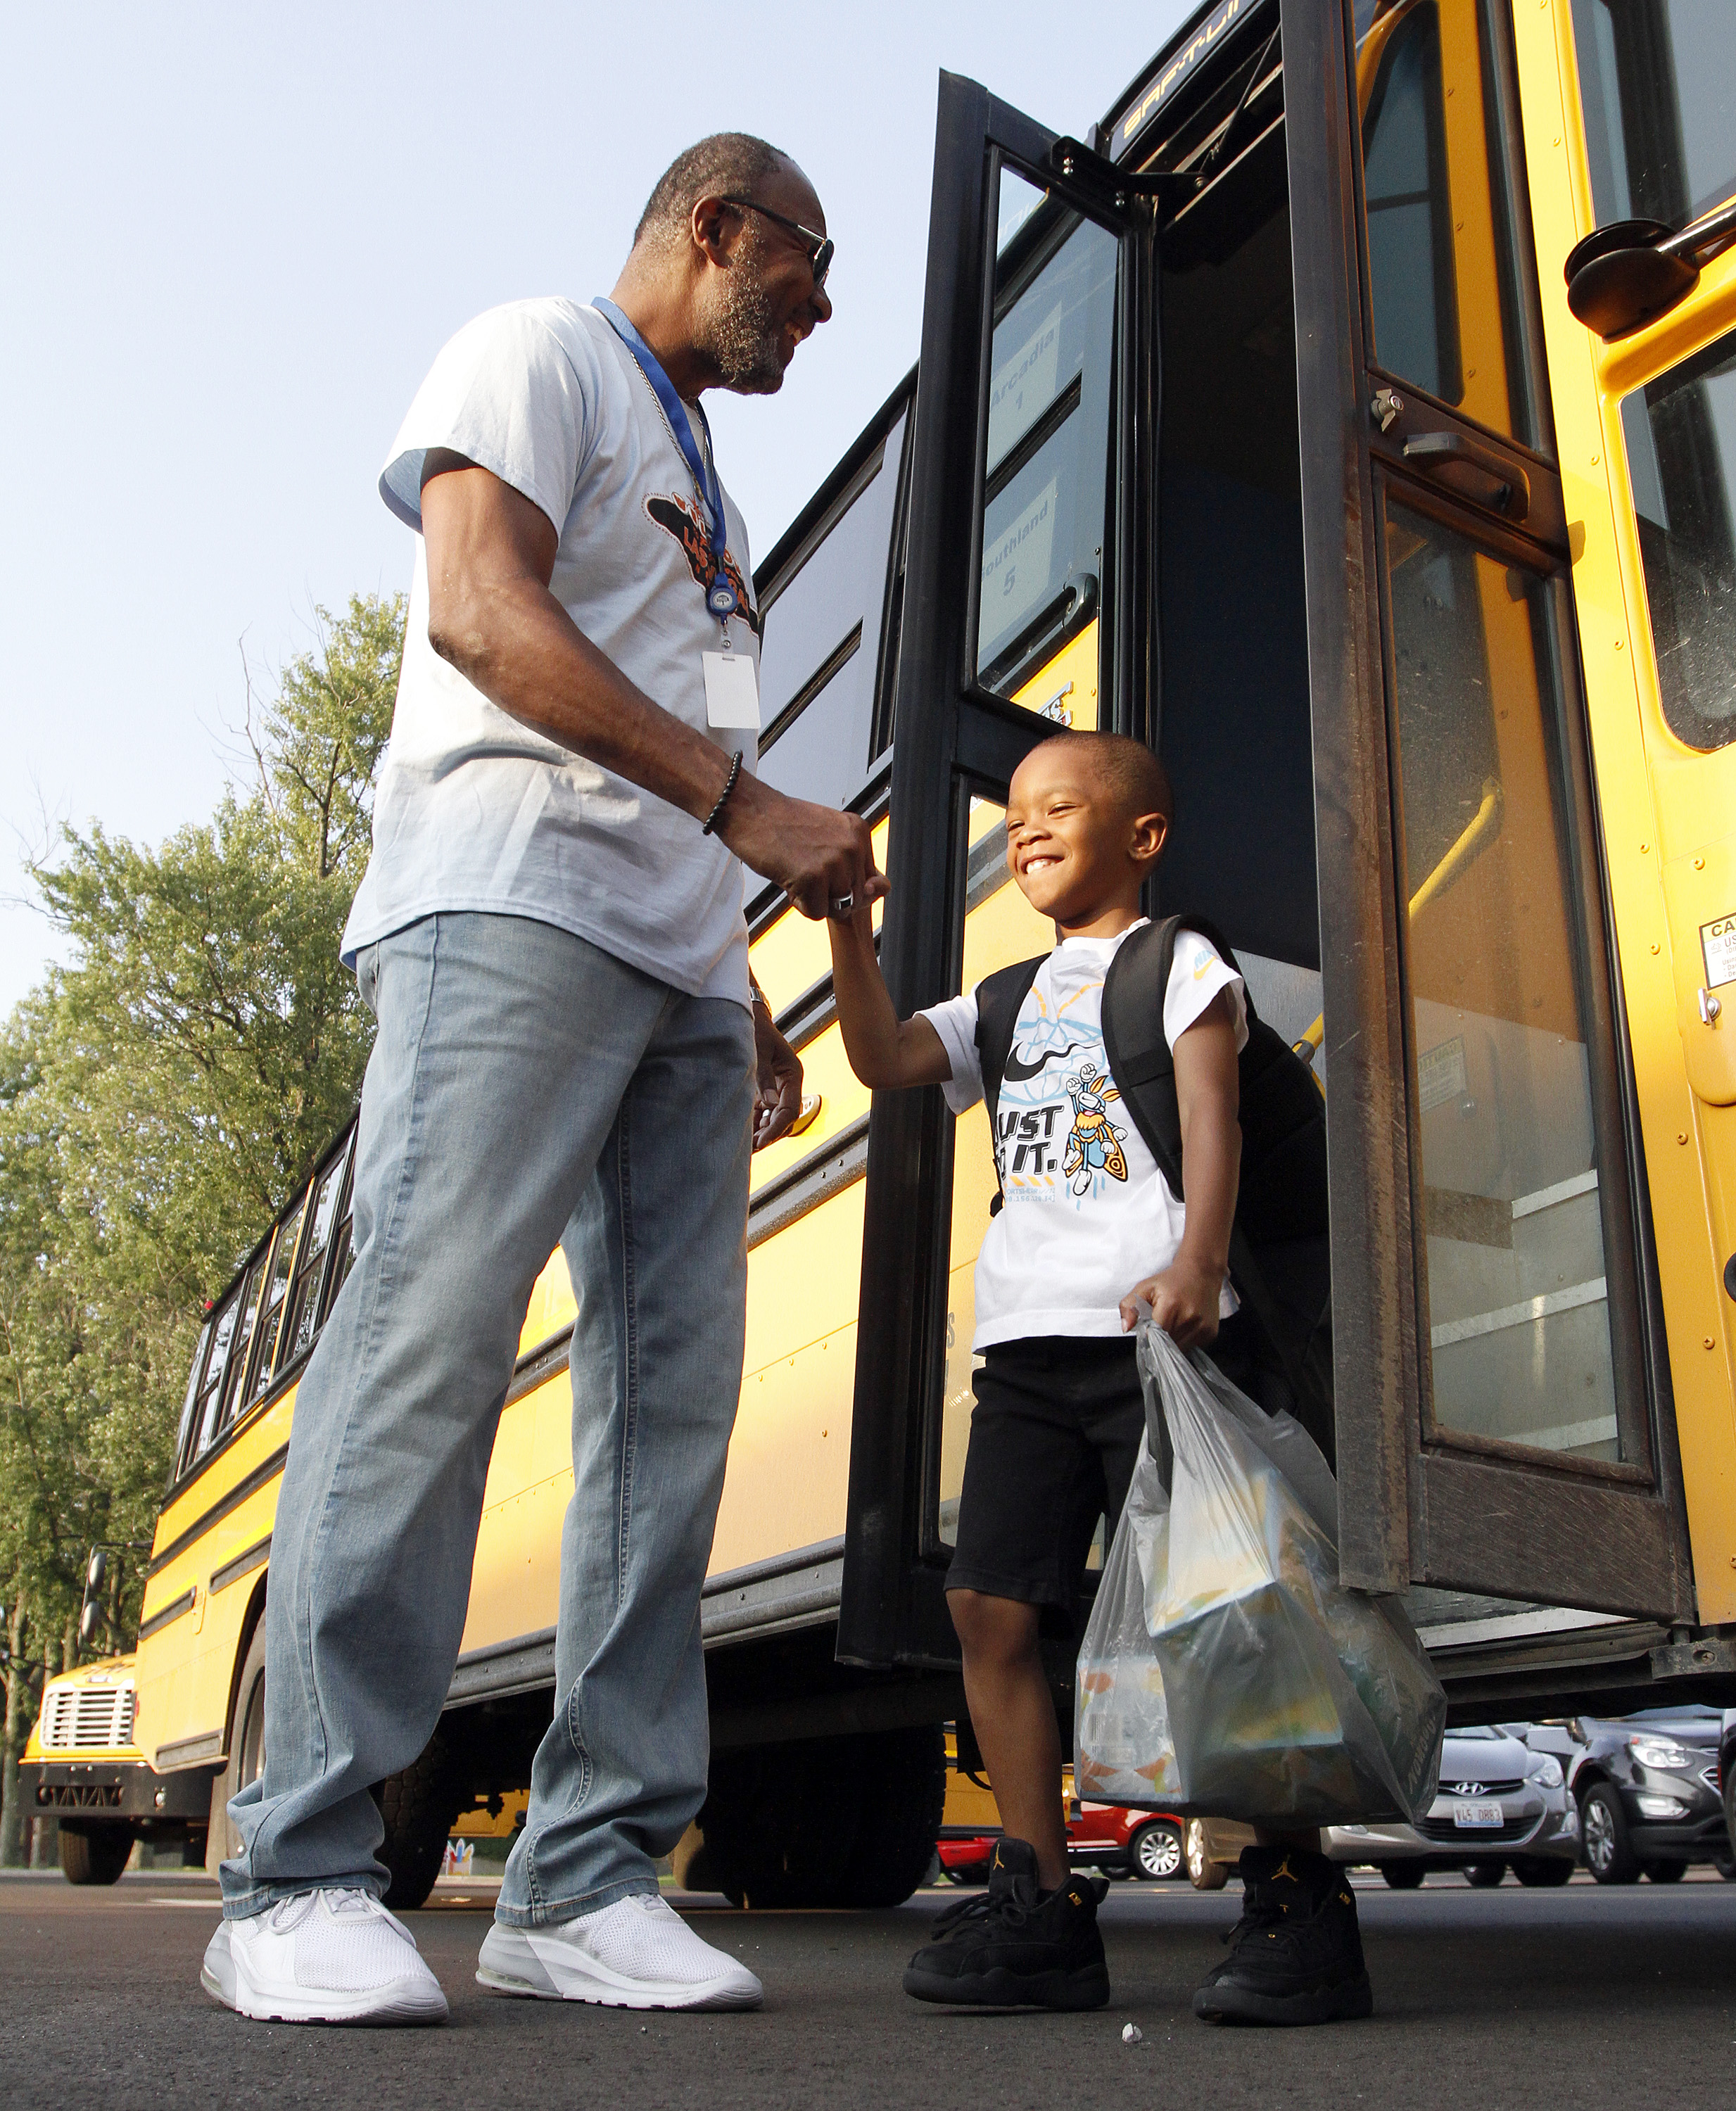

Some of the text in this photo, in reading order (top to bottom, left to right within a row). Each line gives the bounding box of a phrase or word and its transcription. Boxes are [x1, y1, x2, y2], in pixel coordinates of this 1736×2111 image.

[991, 327, 1054, 412] Arcadia
[1015, 391, 1023, 410] 1
[1003, 565, 1016, 596] 5
[1711, 918, 1736, 937] CA
[995, 1105, 1065, 1144] UST
[1012, 1141, 1058, 1175] IT.
